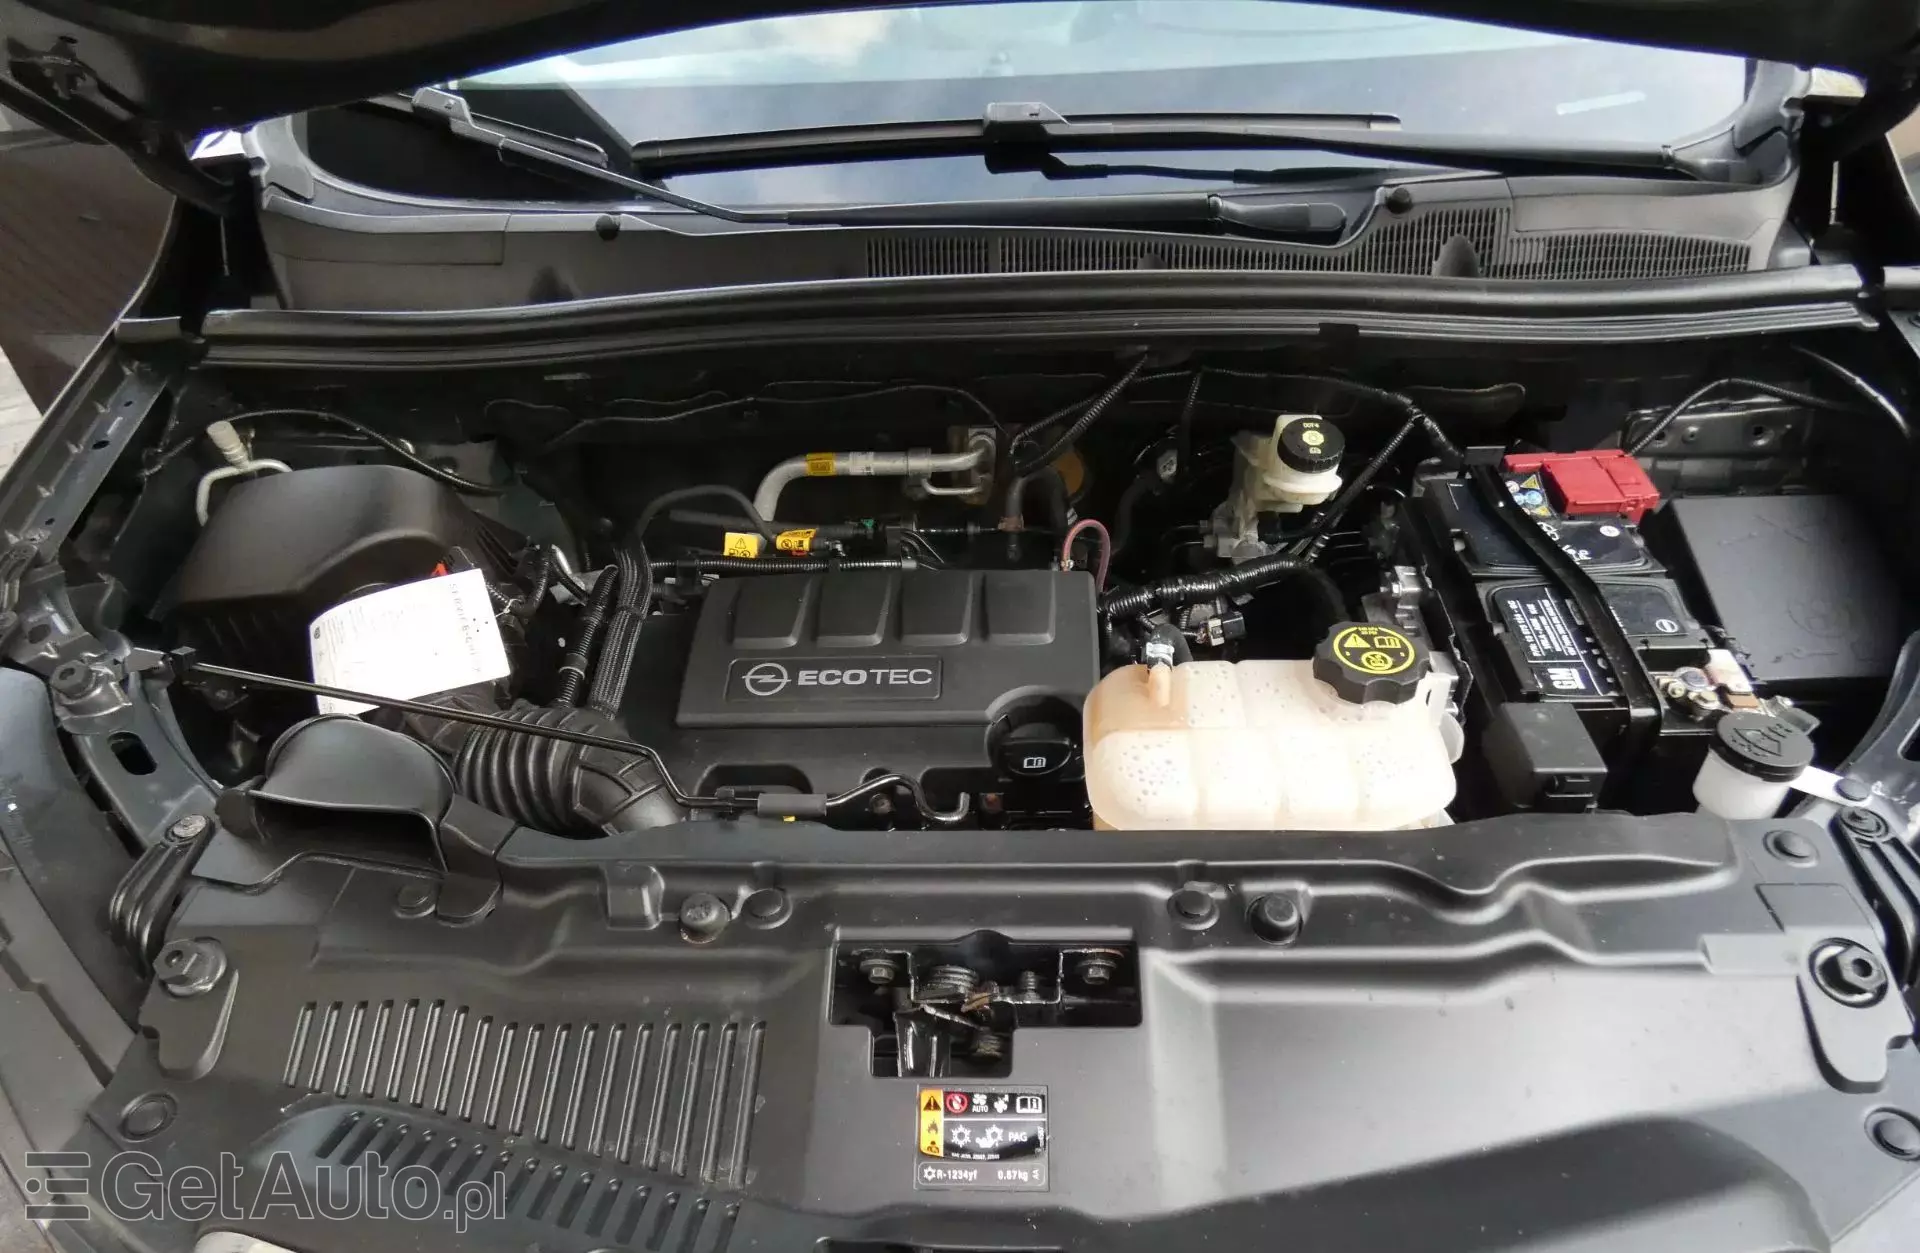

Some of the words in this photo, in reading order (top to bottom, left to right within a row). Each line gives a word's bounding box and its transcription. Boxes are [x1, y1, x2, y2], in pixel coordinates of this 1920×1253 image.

[798, 668, 933, 686] ECOTEC
[972, 1105, 989, 1113] AUTO
[1008, 1131, 1028, 1142] PAG
[936, 1169, 978, 1182] R-1234yf
